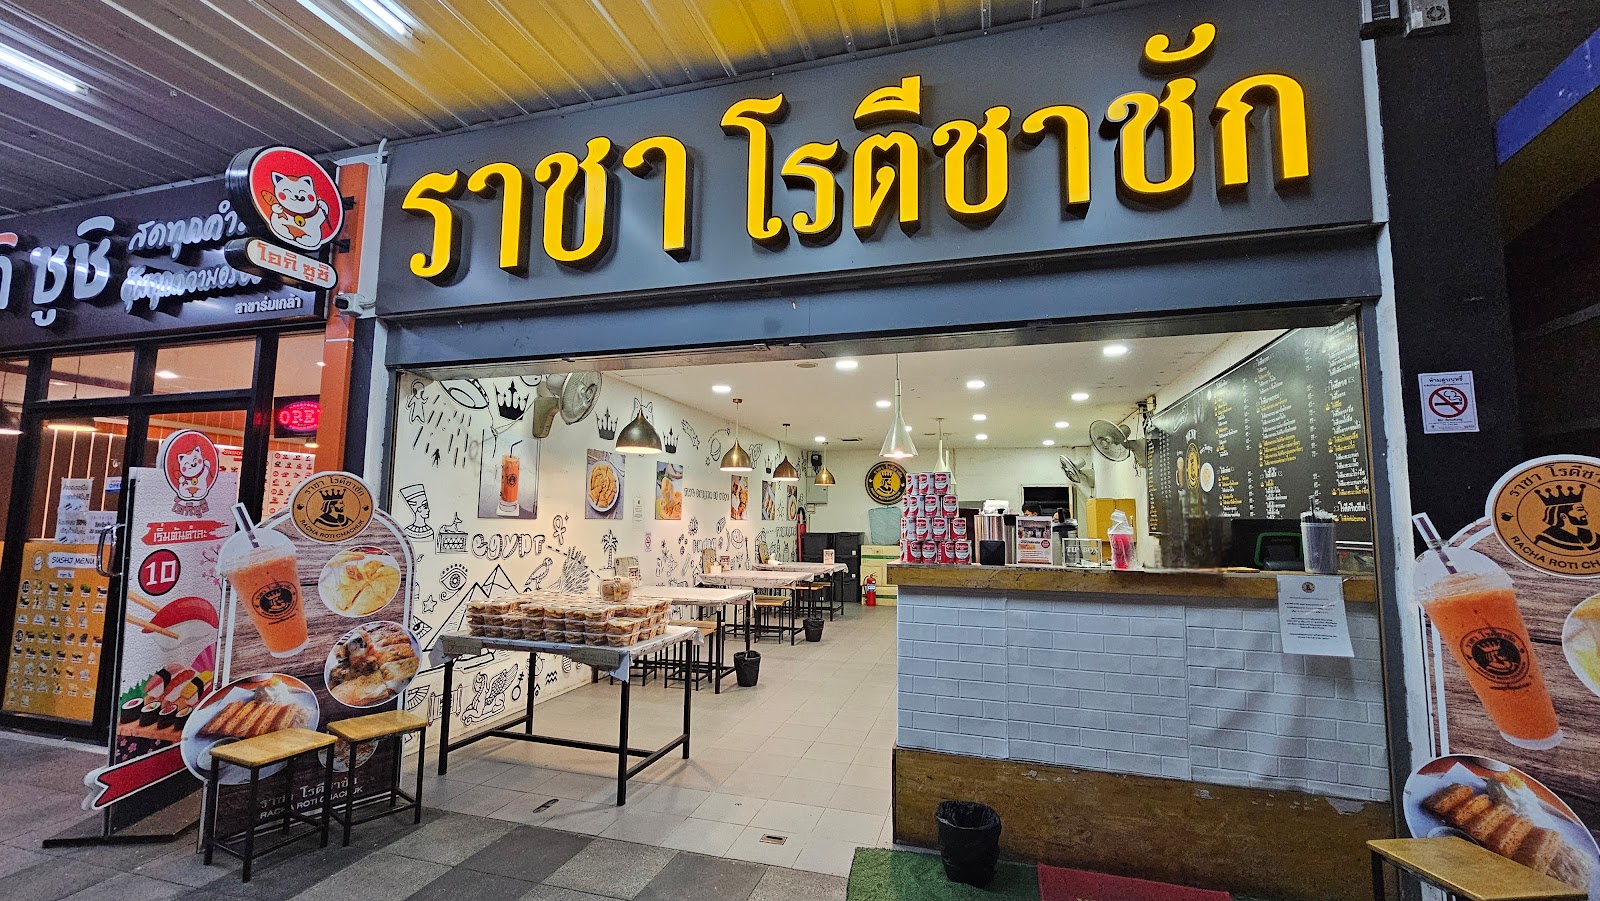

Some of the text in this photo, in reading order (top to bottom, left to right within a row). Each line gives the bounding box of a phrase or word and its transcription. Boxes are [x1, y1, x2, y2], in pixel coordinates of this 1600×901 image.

[404, 23, 1309, 276] ราชา โรตีชาชัก
[235, 294, 303, 314] สาขาร่มเกล้า
[279, 409, 318, 424] OPE
[1509, 474, 1542, 497] ราชา
[300, 519, 318, 536] RACHA
[336, 519, 365, 538] CHACHUK
[1511, 535, 1545, 563] RACHA
[1548, 558, 1579, 570] ROTI
[145, 559, 176, 586] 10
[296, 797, 318, 810] ROTI
